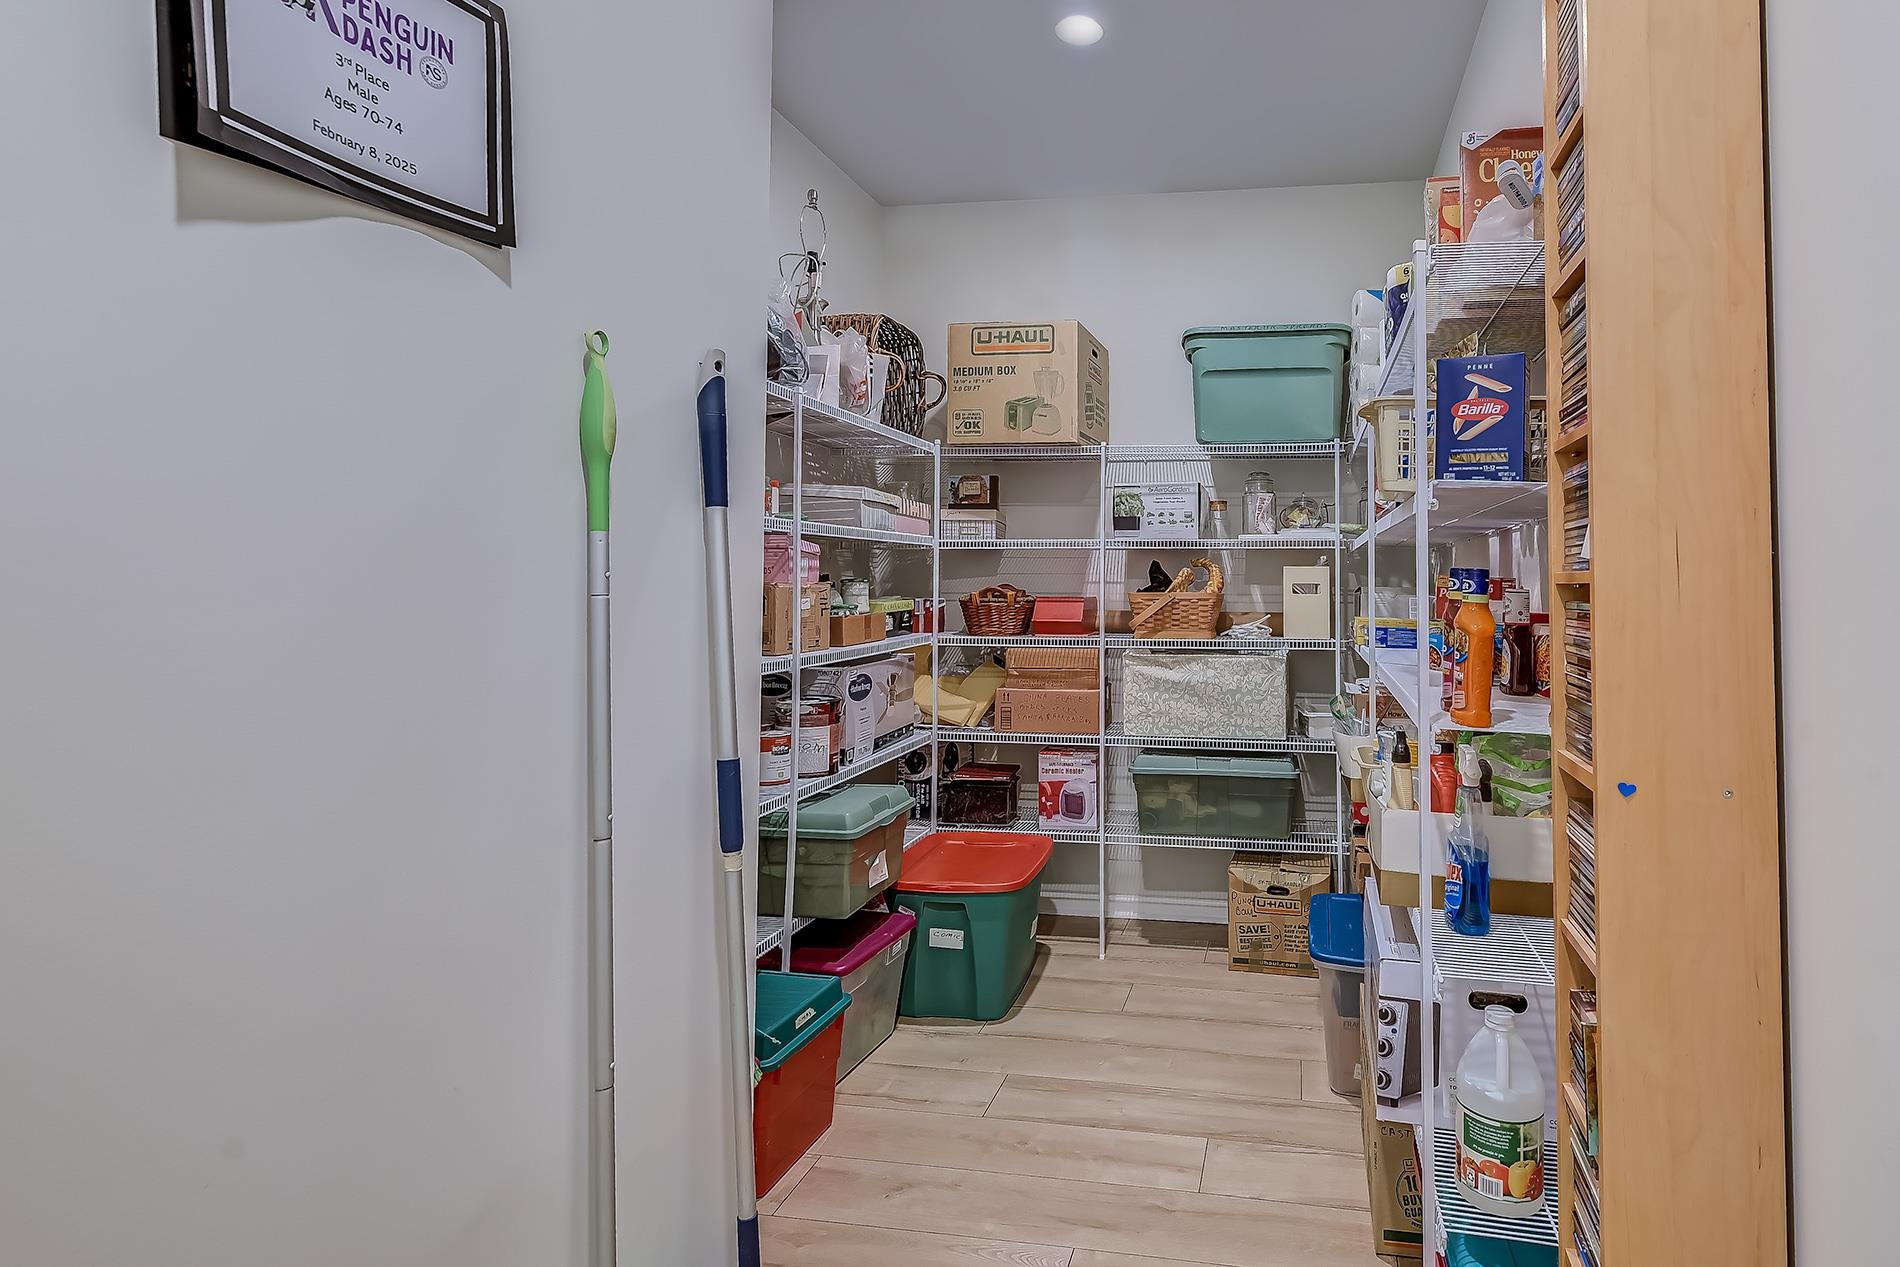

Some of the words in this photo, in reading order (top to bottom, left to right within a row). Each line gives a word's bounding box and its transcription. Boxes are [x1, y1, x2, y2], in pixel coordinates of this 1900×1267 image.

[343, 13, 412, 75] DASH
[335, 53, 352, 68] 3rd
[355, 64, 390, 91] Place
[348, 79, 379, 104] Male
[324, 87, 357, 114] Ages
[361, 105, 404, 135] 70-74
[312, 119, 365, 156] February
[369, 147, 381, 163] 8,
[385, 153, 417, 175] 2025
[977, 330, 1049, 344] U-HAUL
[953, 366, 993, 376] MEDIUM
[997, 366, 1017, 375] BOX
[1458, 403, 1501, 416] Barilla
[964, 421, 981, 430] OK
[1256, 900, 1300, 910] U-HAUL
[1239, 926, 1270, 934] SAVE!
